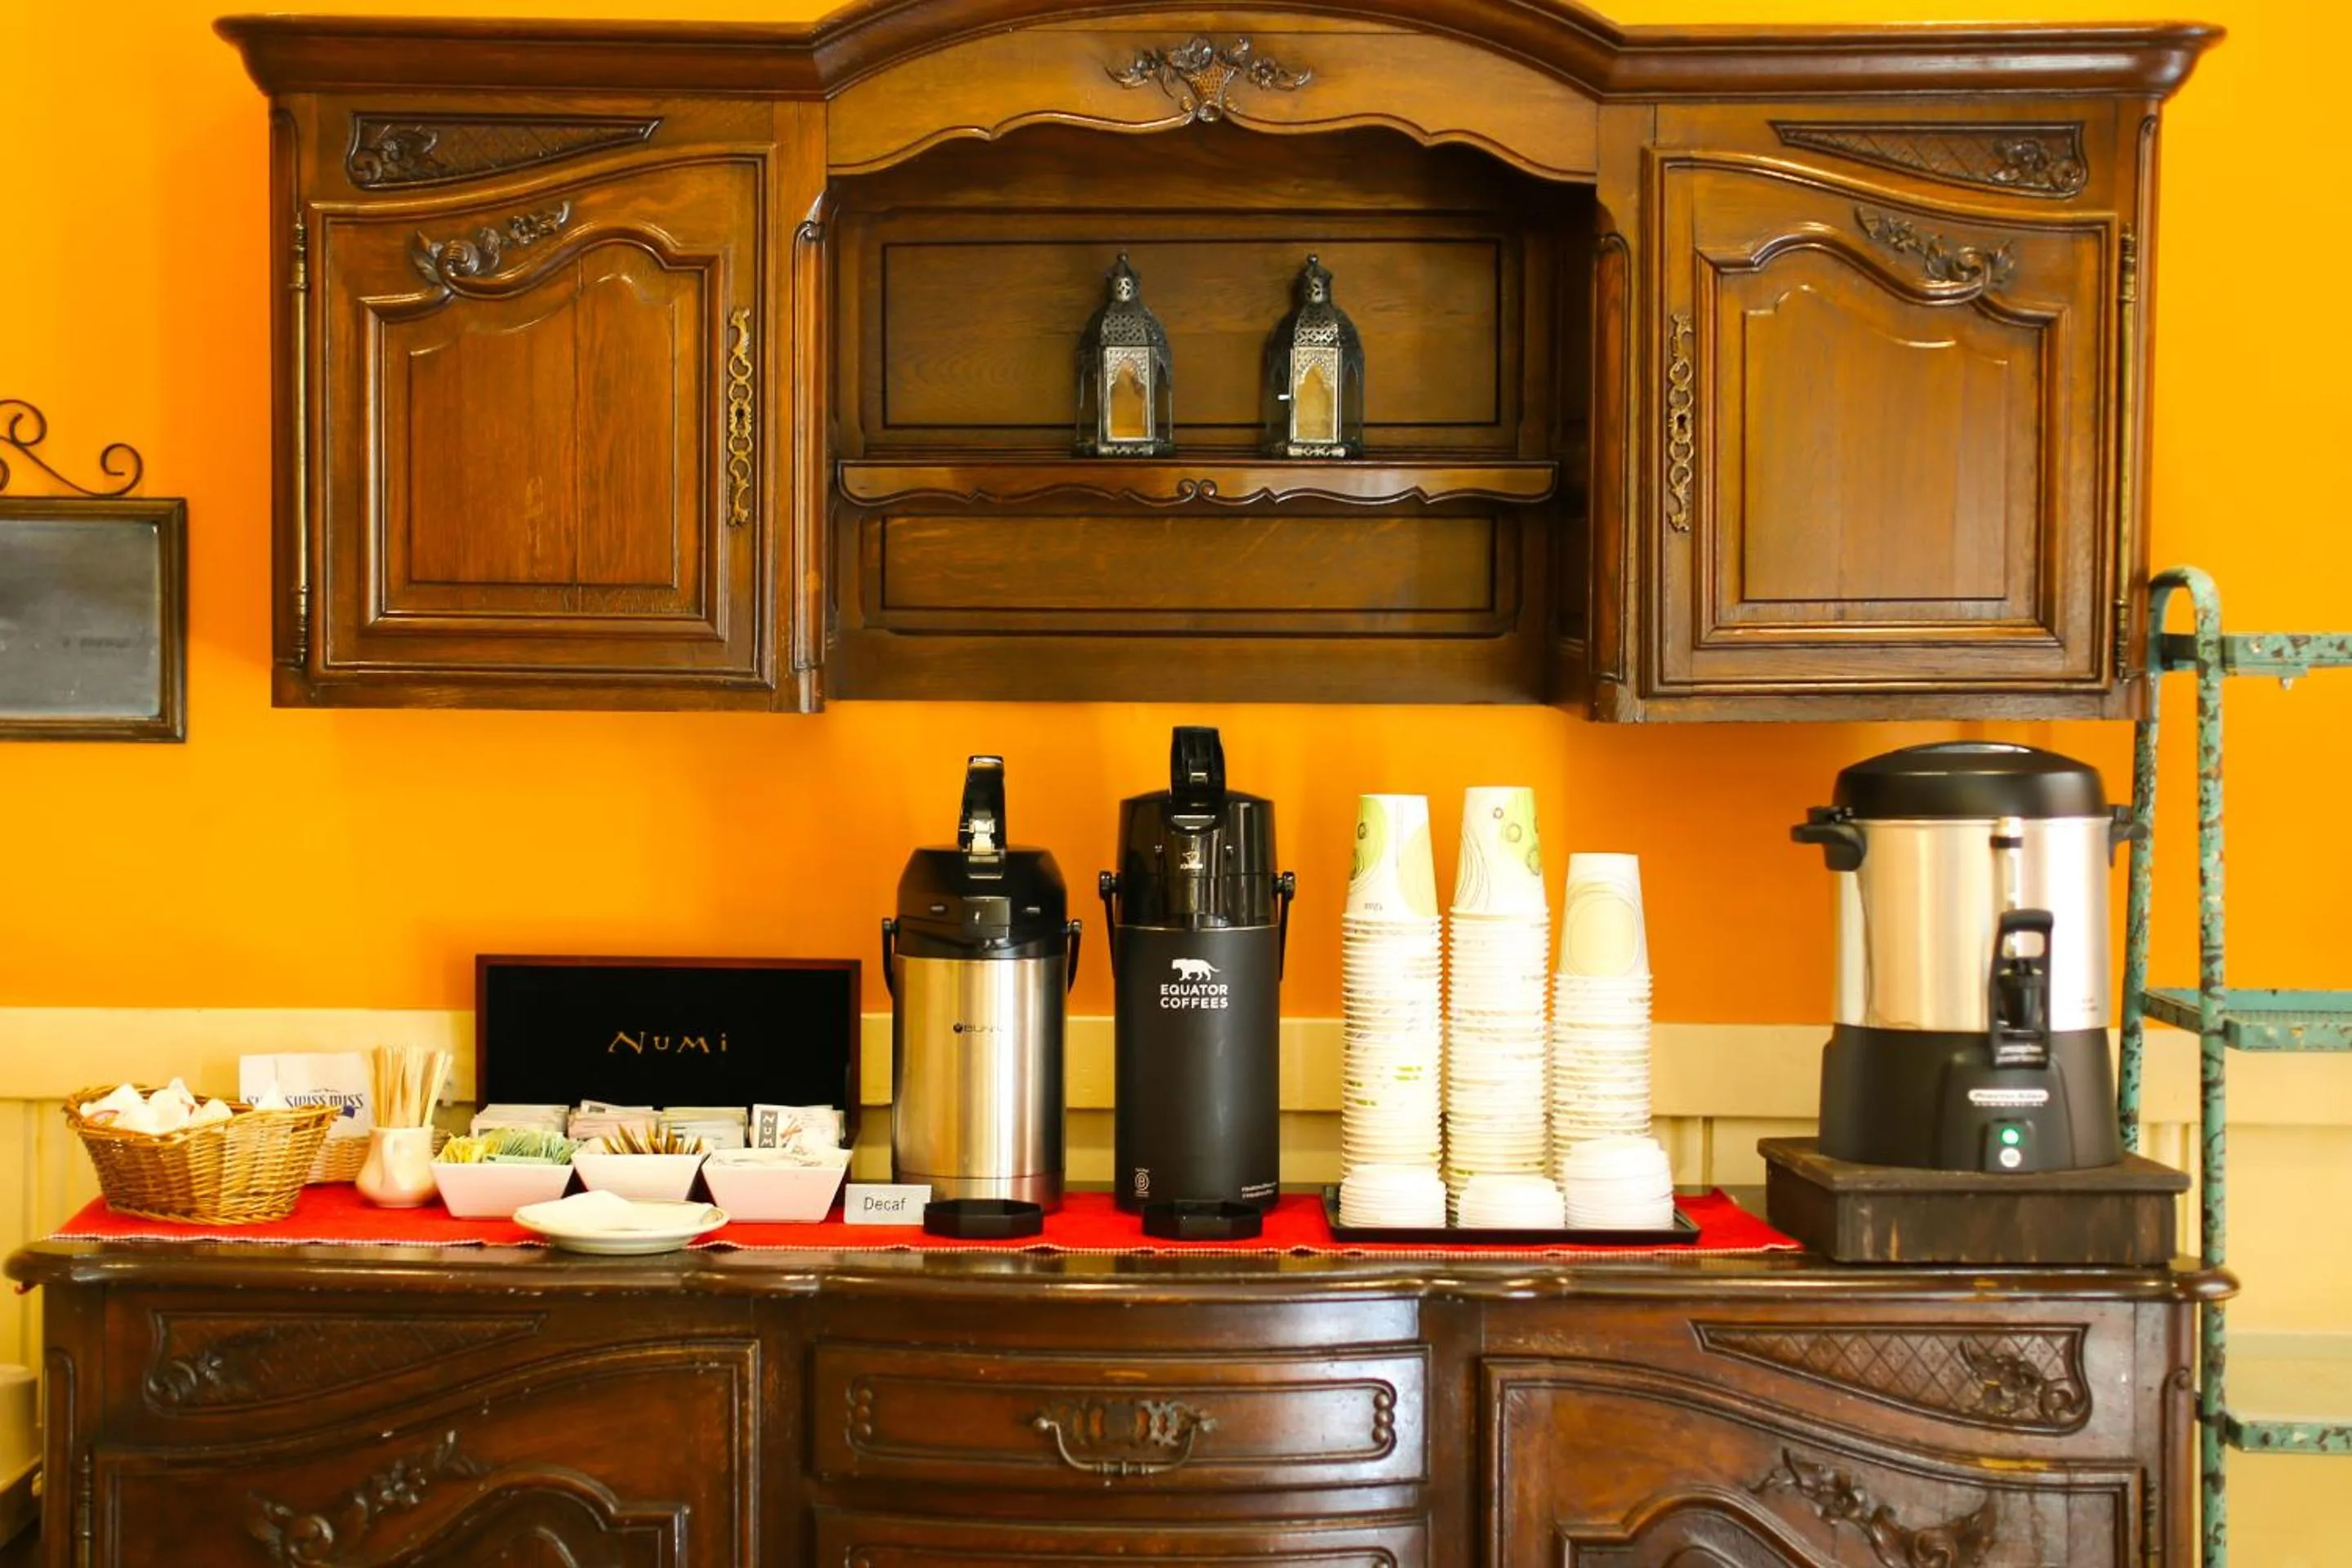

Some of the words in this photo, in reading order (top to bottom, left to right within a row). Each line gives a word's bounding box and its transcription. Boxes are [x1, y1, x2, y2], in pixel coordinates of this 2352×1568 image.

[1160, 984, 1228, 996] EQUATOR
[1160, 997, 1228, 1009] COFFEES
[760, 1115, 774, 1147] NUM
[864, 1196, 906, 1210] Decaf
